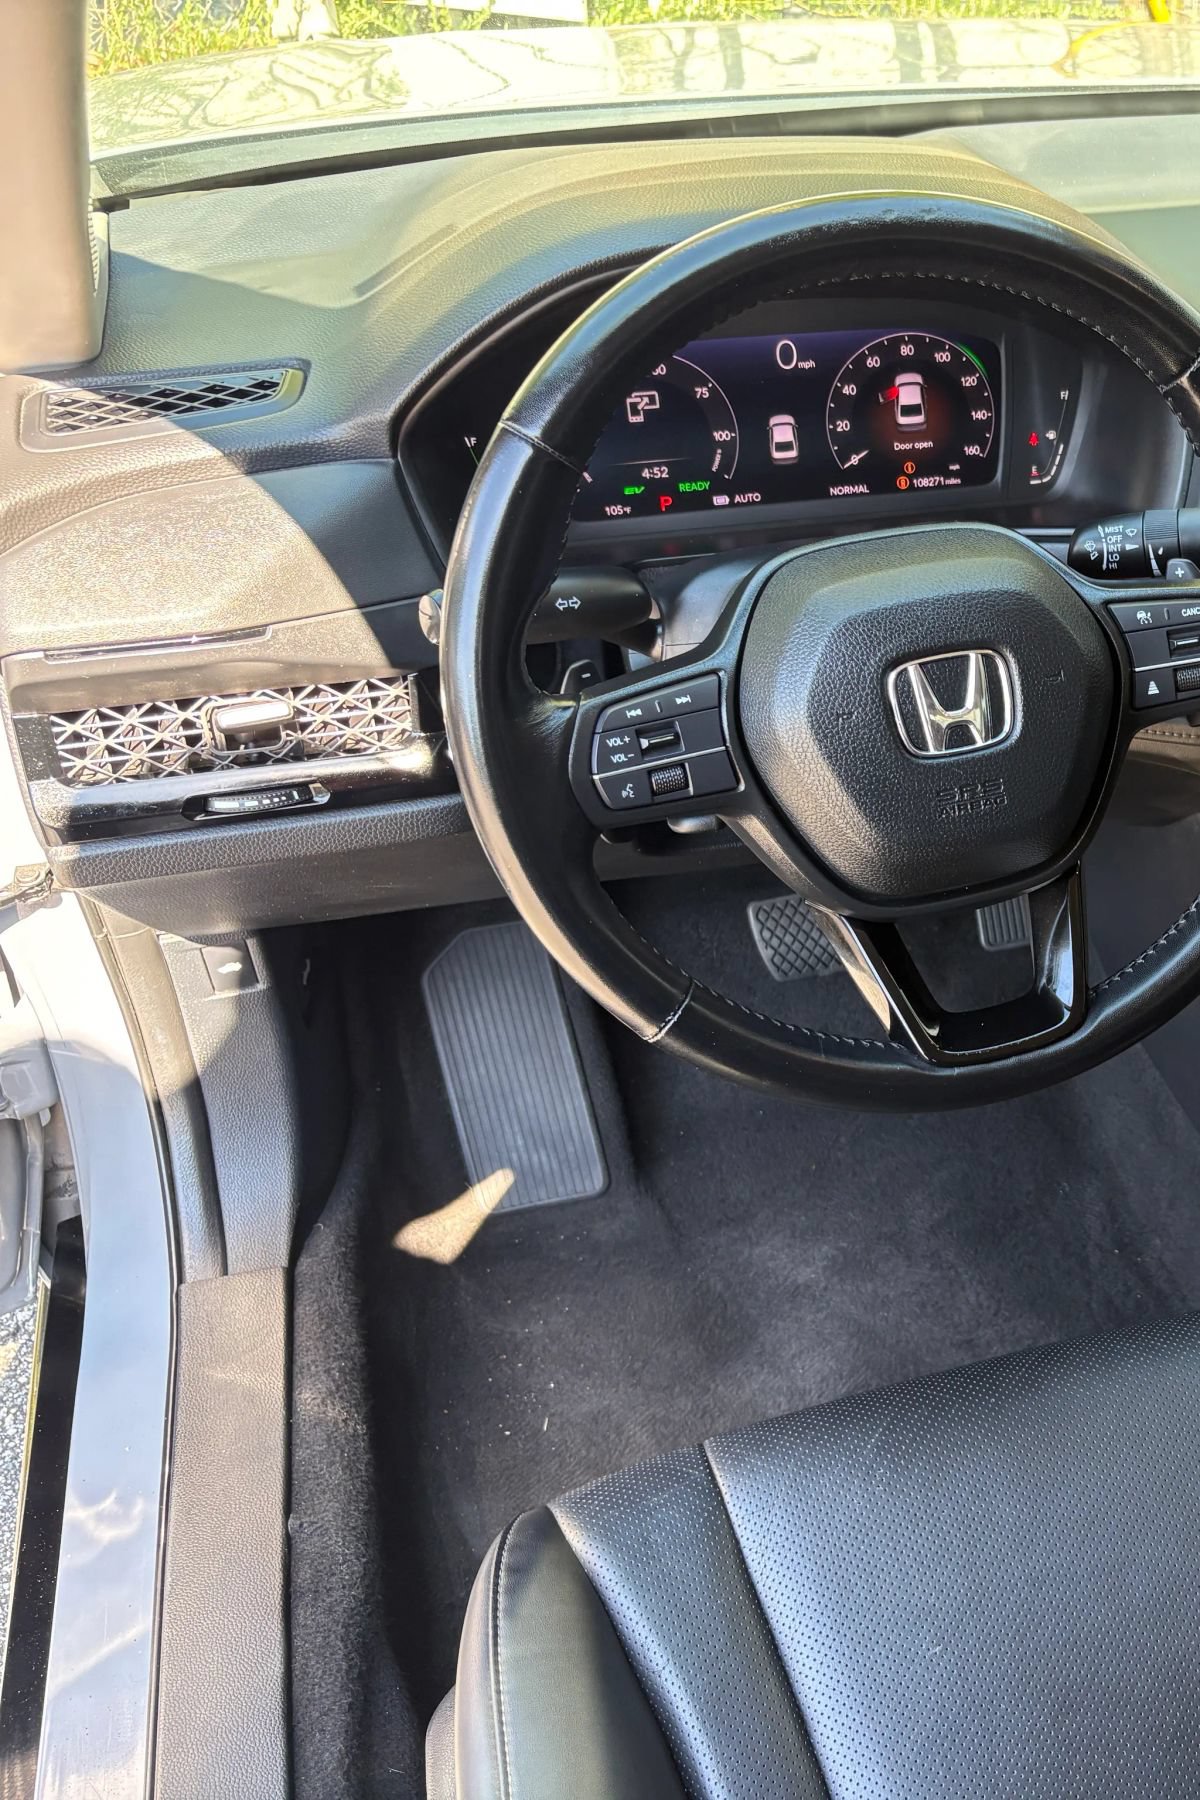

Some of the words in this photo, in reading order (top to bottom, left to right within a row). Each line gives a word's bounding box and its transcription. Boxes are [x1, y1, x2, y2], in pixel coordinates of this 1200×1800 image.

[775, 339, 798, 370] 0
[797, 358, 816, 370] mph
[900, 345, 914, 356] 80
[866, 356, 881, 368] 60
[934, 351, 951, 363] 100
[961, 376, 977, 388] 120
[694, 387, 710, 399] 75
[842, 385, 857, 396] 40
[1060, 390, 1066, 400] F
[971, 410, 988, 421] 140
[836, 420, 851, 432] 20
[470, 436, 477, 447] F
[713, 430, 731, 442] 100
[893, 441, 914, 451] Door
[914, 441, 934, 451] open
[963, 445, 980, 456] 160
[641, 467, 669, 480] 4:52
[678, 480, 710, 493] READY
[912, 476, 945, 488] 108271
[945, 477, 961, 485] miles
[623, 485, 645, 495] EV
[829, 485, 870, 496] NORMAL
[659, 495, 673, 512] P
[734, 492, 762, 504] AUTO
[1104, 525, 1124, 534] MIST
[1106, 535, 1123, 544] OFF
[1108, 544, 1122, 553] INT
[1108, 553, 1120, 562] LO
[1108, 562, 1118, 570] HI
[606, 735, 631, 748] VOL+
[937, 779, 1005, 801] SRS
[938, 794, 1008, 819] AIRBAG
